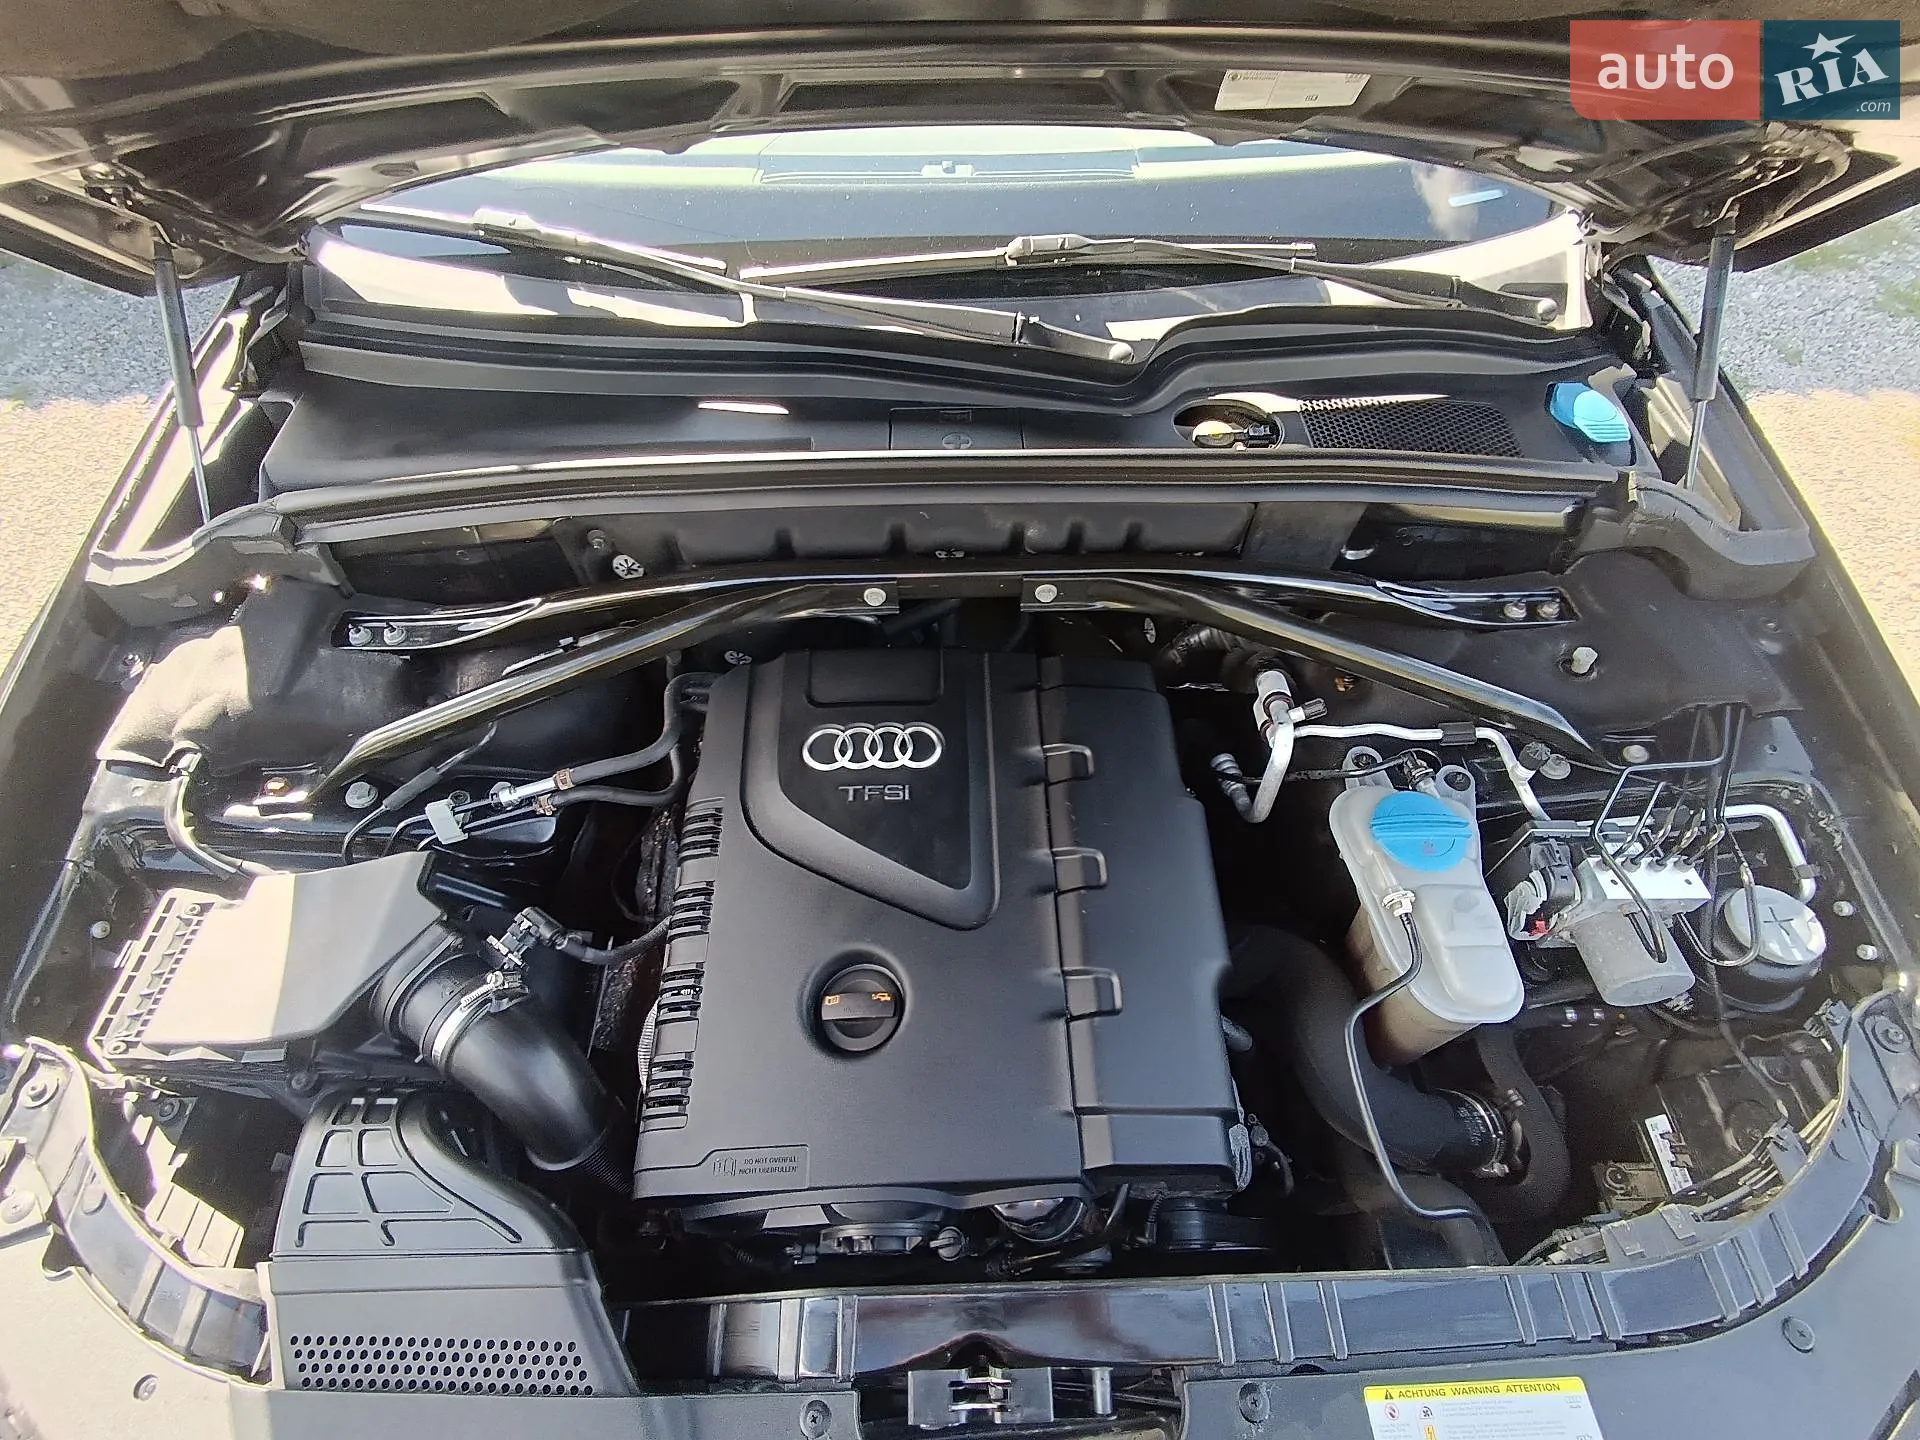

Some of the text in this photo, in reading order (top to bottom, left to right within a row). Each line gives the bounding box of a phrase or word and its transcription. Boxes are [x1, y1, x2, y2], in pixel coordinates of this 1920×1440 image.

[838, 783, 911, 803] TFSI
[1398, 1383, 1561, 1399] ACHTUNG WARNING ATTENTION
